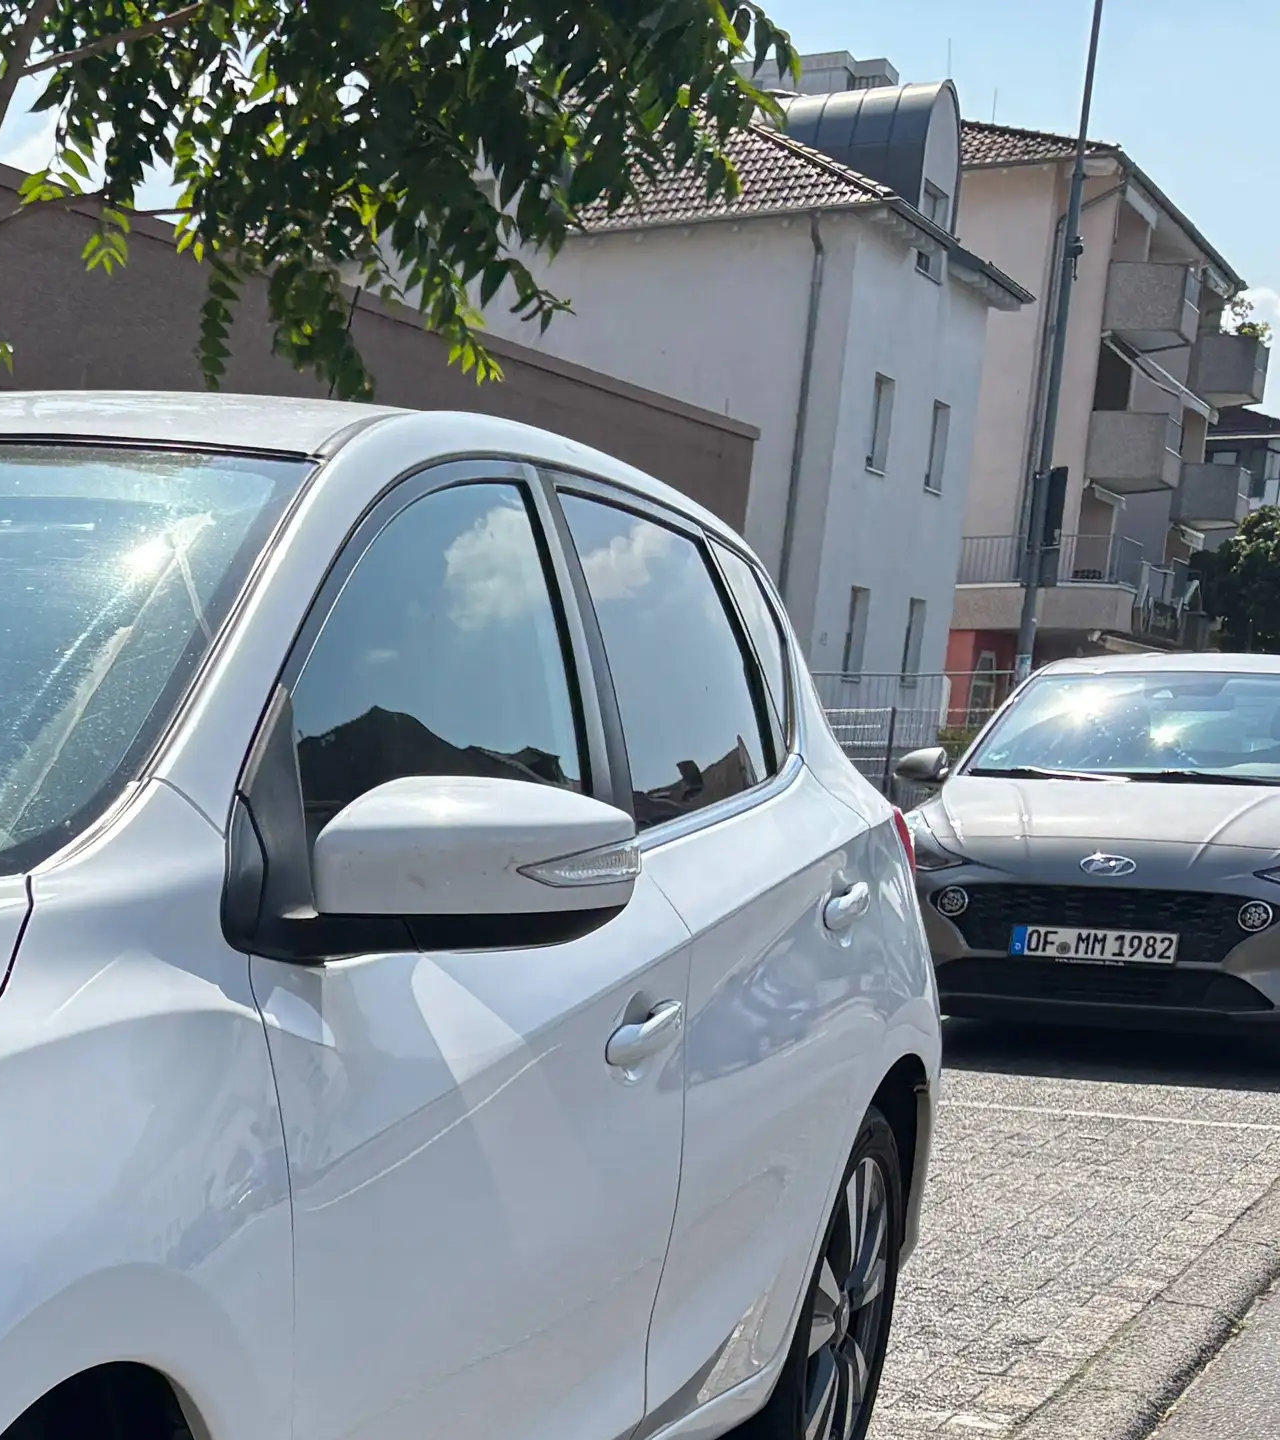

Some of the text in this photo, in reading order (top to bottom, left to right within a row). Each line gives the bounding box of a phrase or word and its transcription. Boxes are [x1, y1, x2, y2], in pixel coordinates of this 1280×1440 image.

[1026, 929, 1175, 960] OF MM 1982
